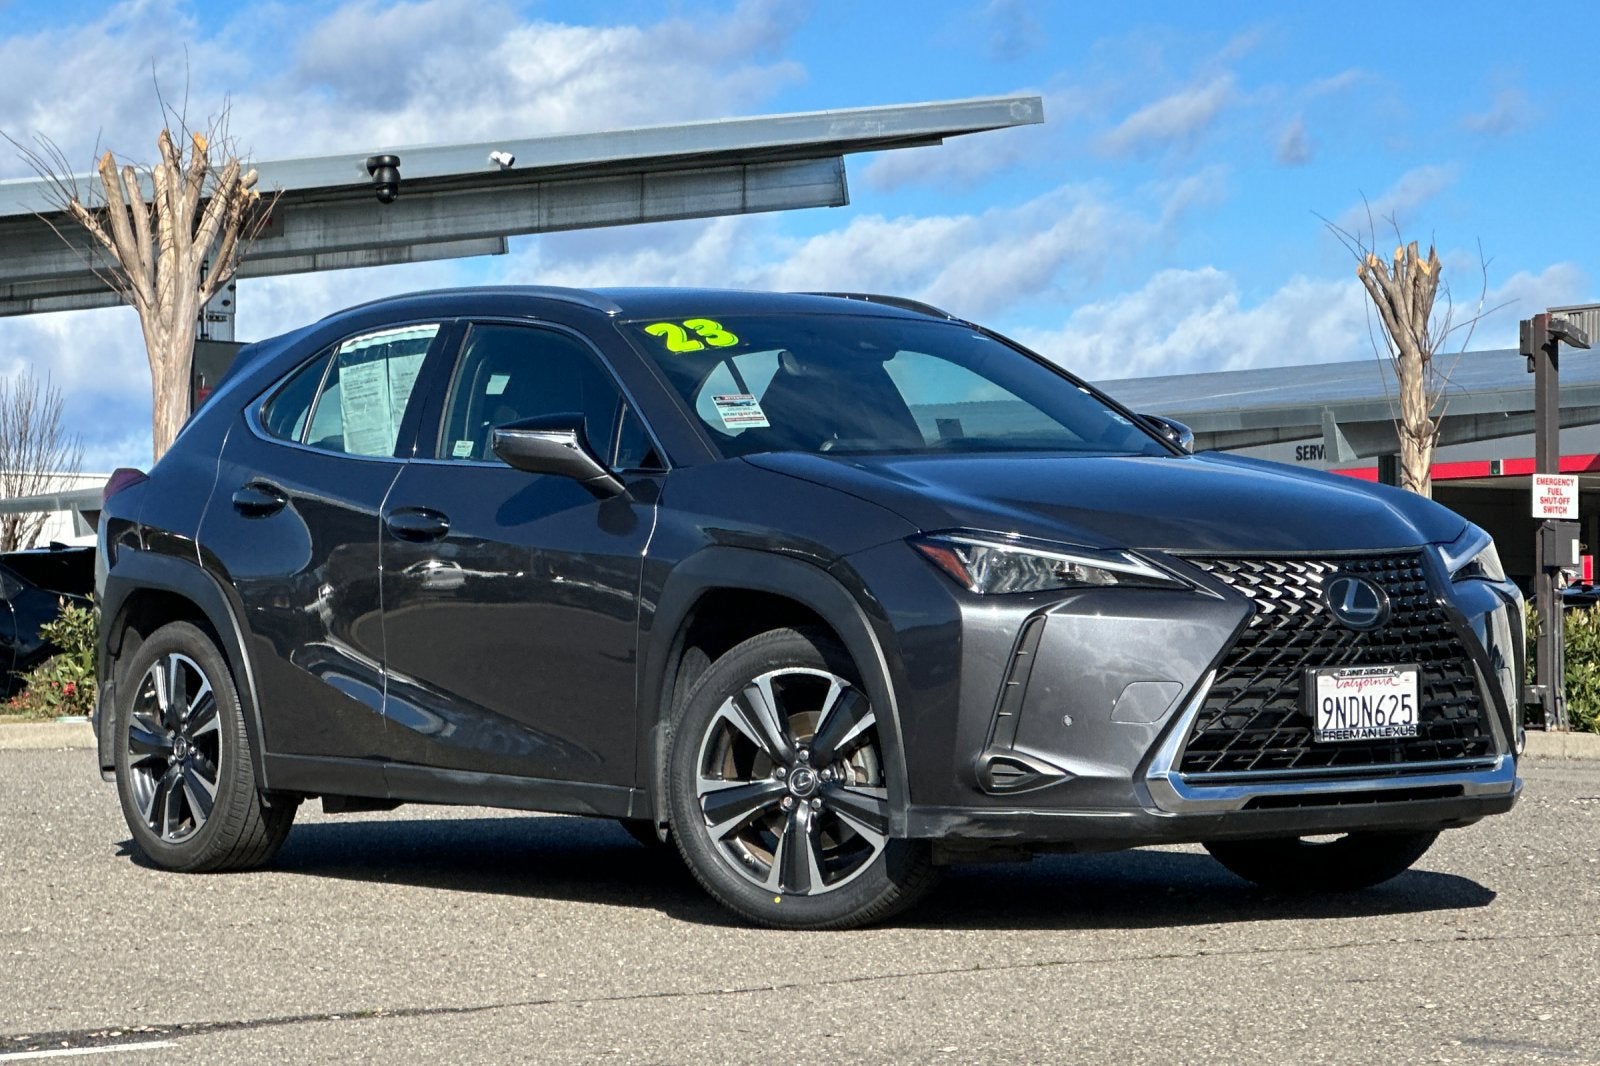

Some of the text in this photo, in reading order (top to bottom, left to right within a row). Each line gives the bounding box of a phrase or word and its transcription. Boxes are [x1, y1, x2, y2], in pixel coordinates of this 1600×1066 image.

[644, 318, 739, 352] 23
[1536, 477, 1574, 487] EMERGENCY
[1547, 487, 1563, 496] FUEL
[1540, 496, 1570, 505] SHUT-OFF
[1543, 506, 1568, 515] SWITCH
[1336, 677, 1400, 693] California
[1323, 693, 1413, 730] 9NDN625
[1322, 726, 1416, 741] FREEMAN LEXUS
